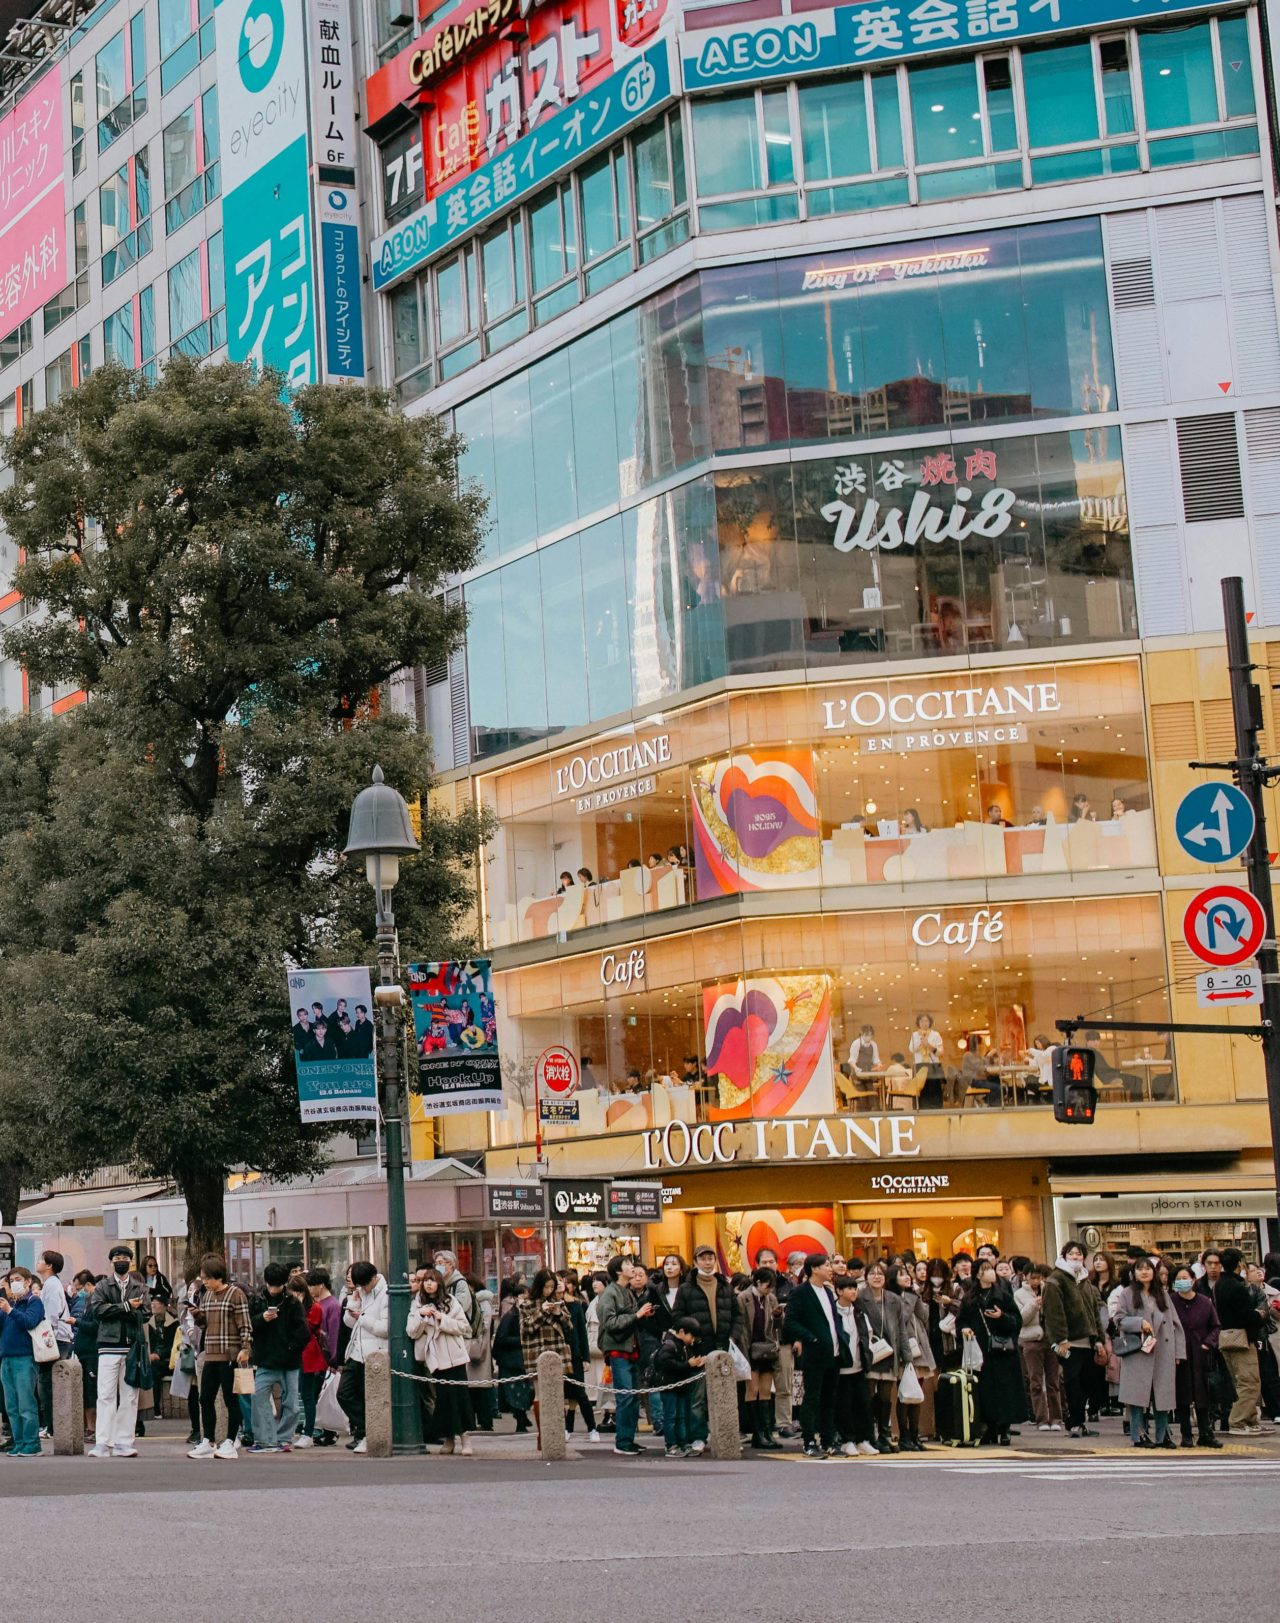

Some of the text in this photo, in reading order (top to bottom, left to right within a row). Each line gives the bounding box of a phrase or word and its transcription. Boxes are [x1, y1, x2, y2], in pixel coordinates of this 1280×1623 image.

[700, 23, 816, 75] AEON
[320, 20, 344, 142] 献血ルーム
[486, 20, 600, 157] ガスト
[230, 78, 300, 157] eyecity
[326, 149, 345, 163] 6F
[386, 144, 422, 206] 7F
[444, 97, 612, 236] 英会話イーオン
[323, 210, 353, 222] eyecity
[380, 216, 429, 274] AEON
[333, 230, 353, 370] コンタクトのアイシティ
[801, 271, 847, 291] King
[834, 448, 997, 496] 渋谷焼肉
[821, 487, 1017, 553] Ushi8
[822, 683, 1062, 729] L'OCCITANE
[868, 727, 1020, 751] EN PROVENCE
[556, 734, 672, 794] L'OCCITANE
[578, 779, 652, 811] EN PROVENCE
[911, 910, 1004, 954] Café
[600, 950, 645, 990] Café
[1235, 974, 1252, 987] 20
[545, 1065, 571, 1081] 消火栓
[542, 1106, 577, 1115] 在宅ワーク
[871, 1174, 950, 1189] L'OCCITANE
[1151, 1194, 1242, 1216] ploom STATION
